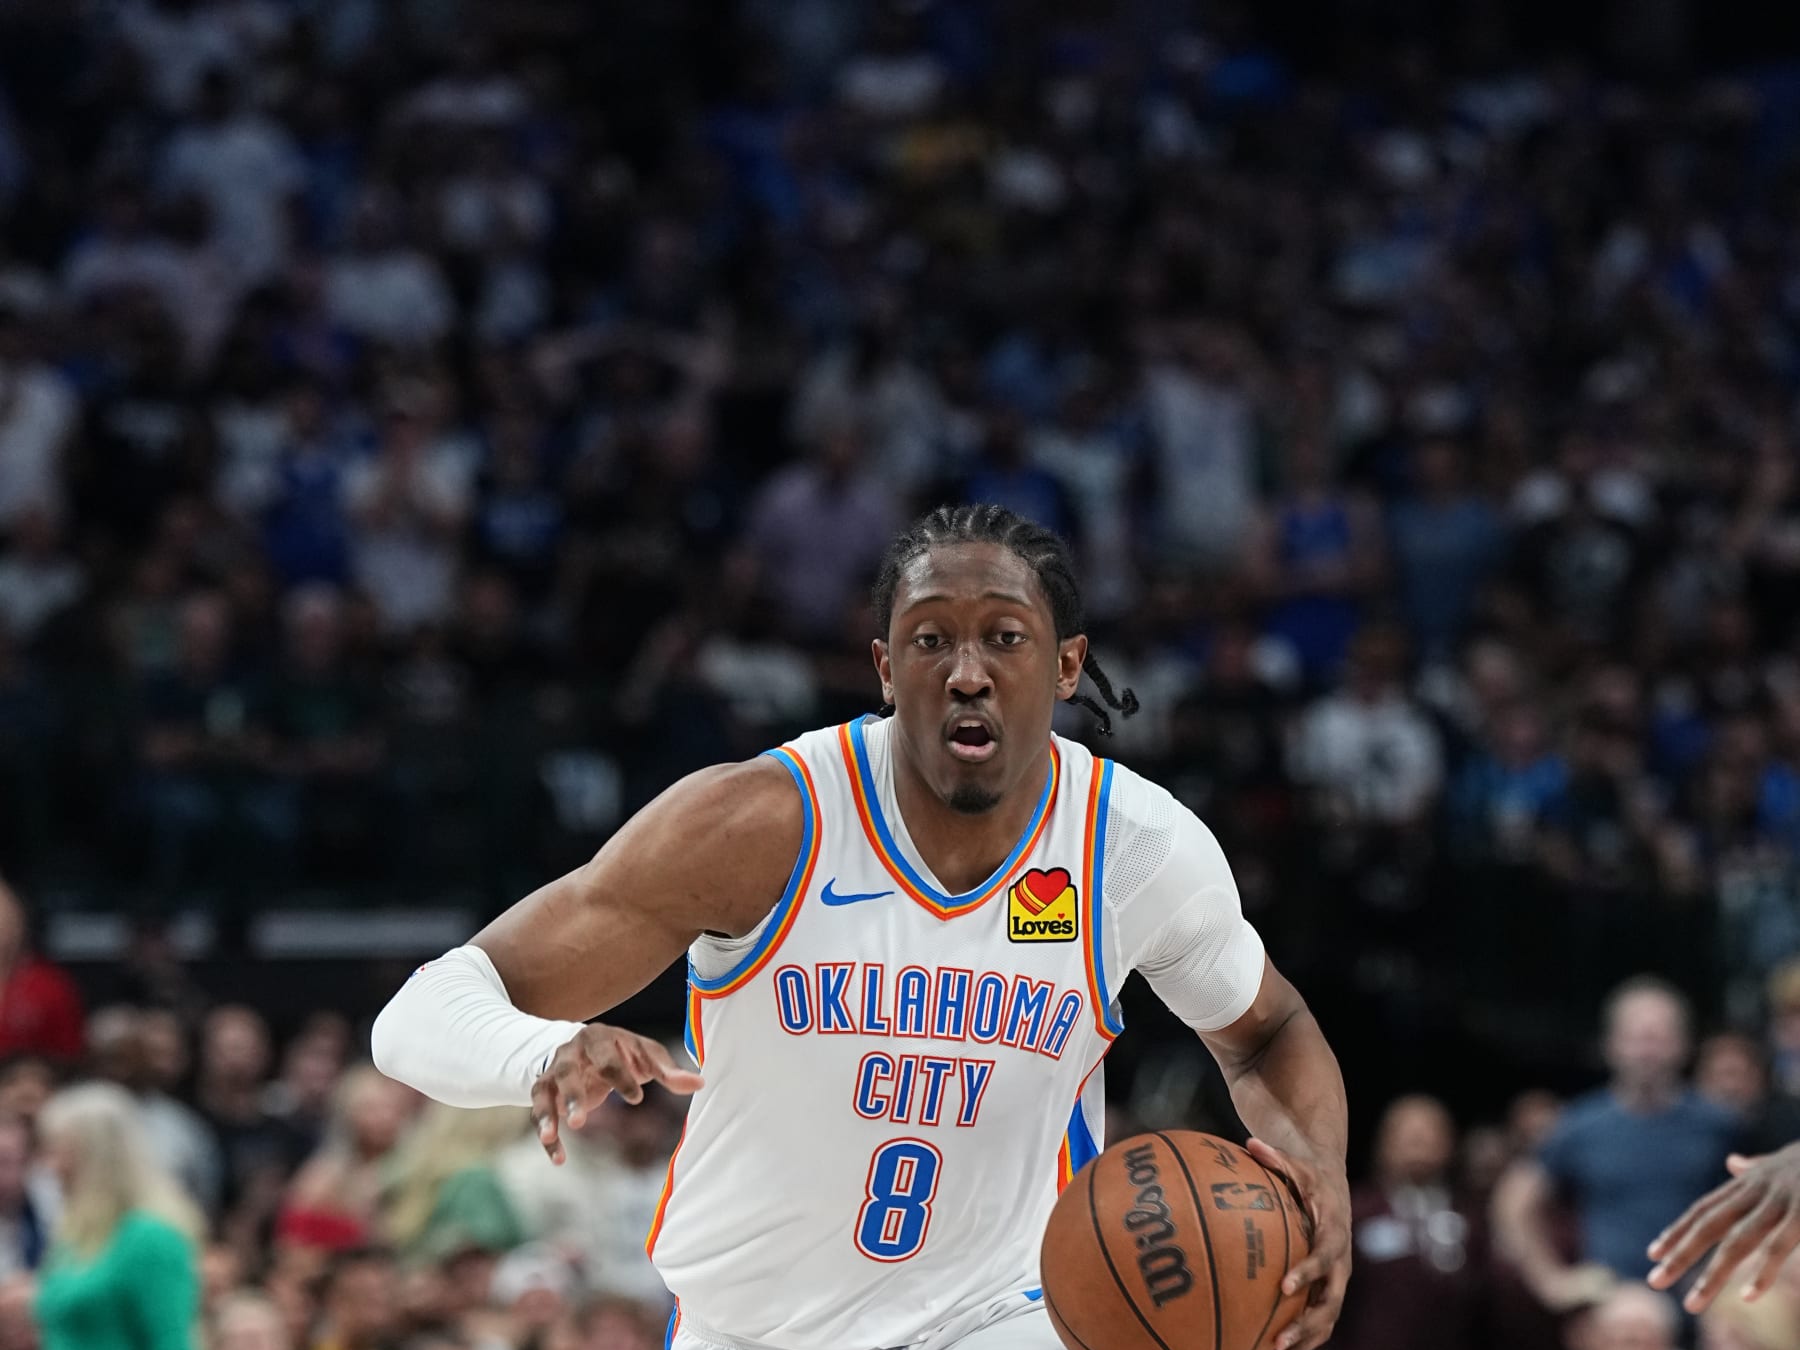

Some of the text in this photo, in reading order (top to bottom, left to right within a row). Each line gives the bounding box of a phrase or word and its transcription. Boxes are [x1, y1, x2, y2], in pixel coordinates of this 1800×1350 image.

[774, 962, 1083, 1060] OKLAHOMA
[853, 1051, 995, 1127] CITY
[853, 1137, 943, 1264] 8
[1122, 1143, 1195, 1310] Wilson
